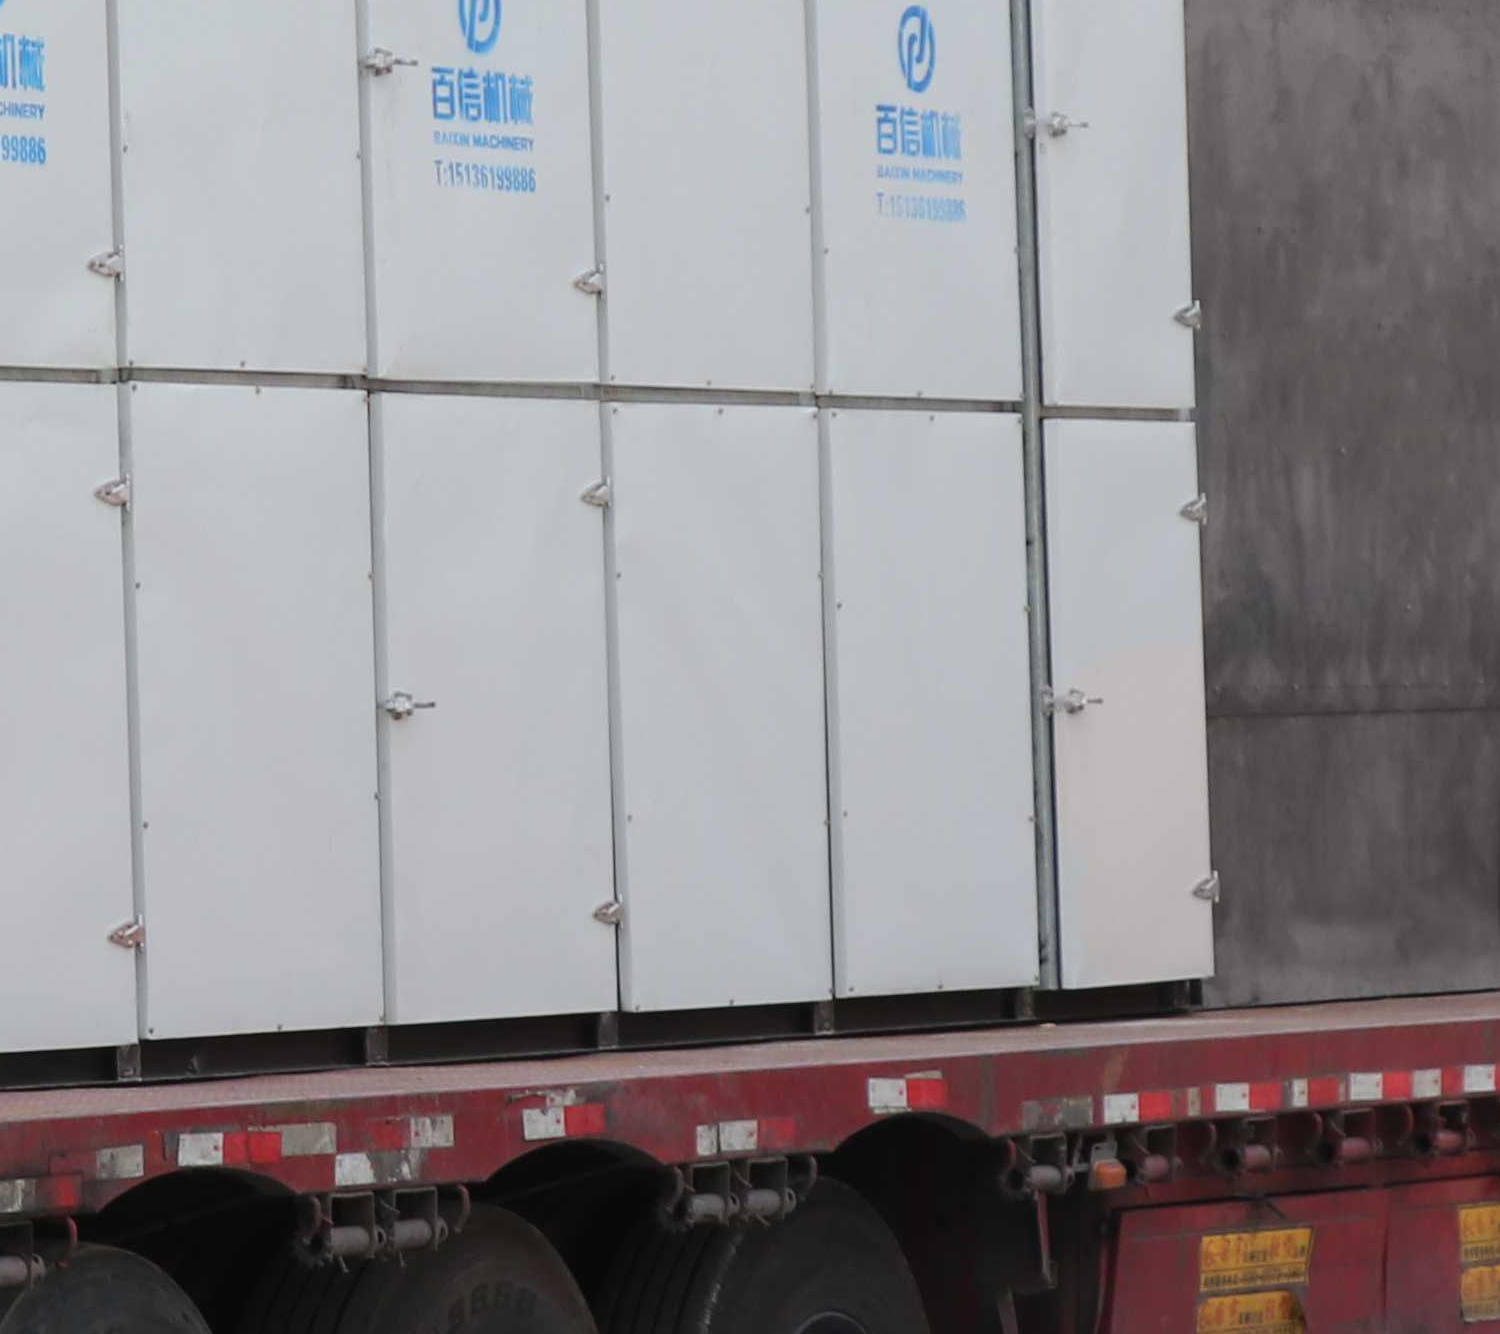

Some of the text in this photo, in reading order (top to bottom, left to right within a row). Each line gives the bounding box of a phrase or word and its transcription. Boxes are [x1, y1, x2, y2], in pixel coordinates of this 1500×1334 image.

[431, 66, 534, 125] 百信机械
[473, 133, 535, 152] MACHINERY
[434, 160, 537, 192] T:15136199886
